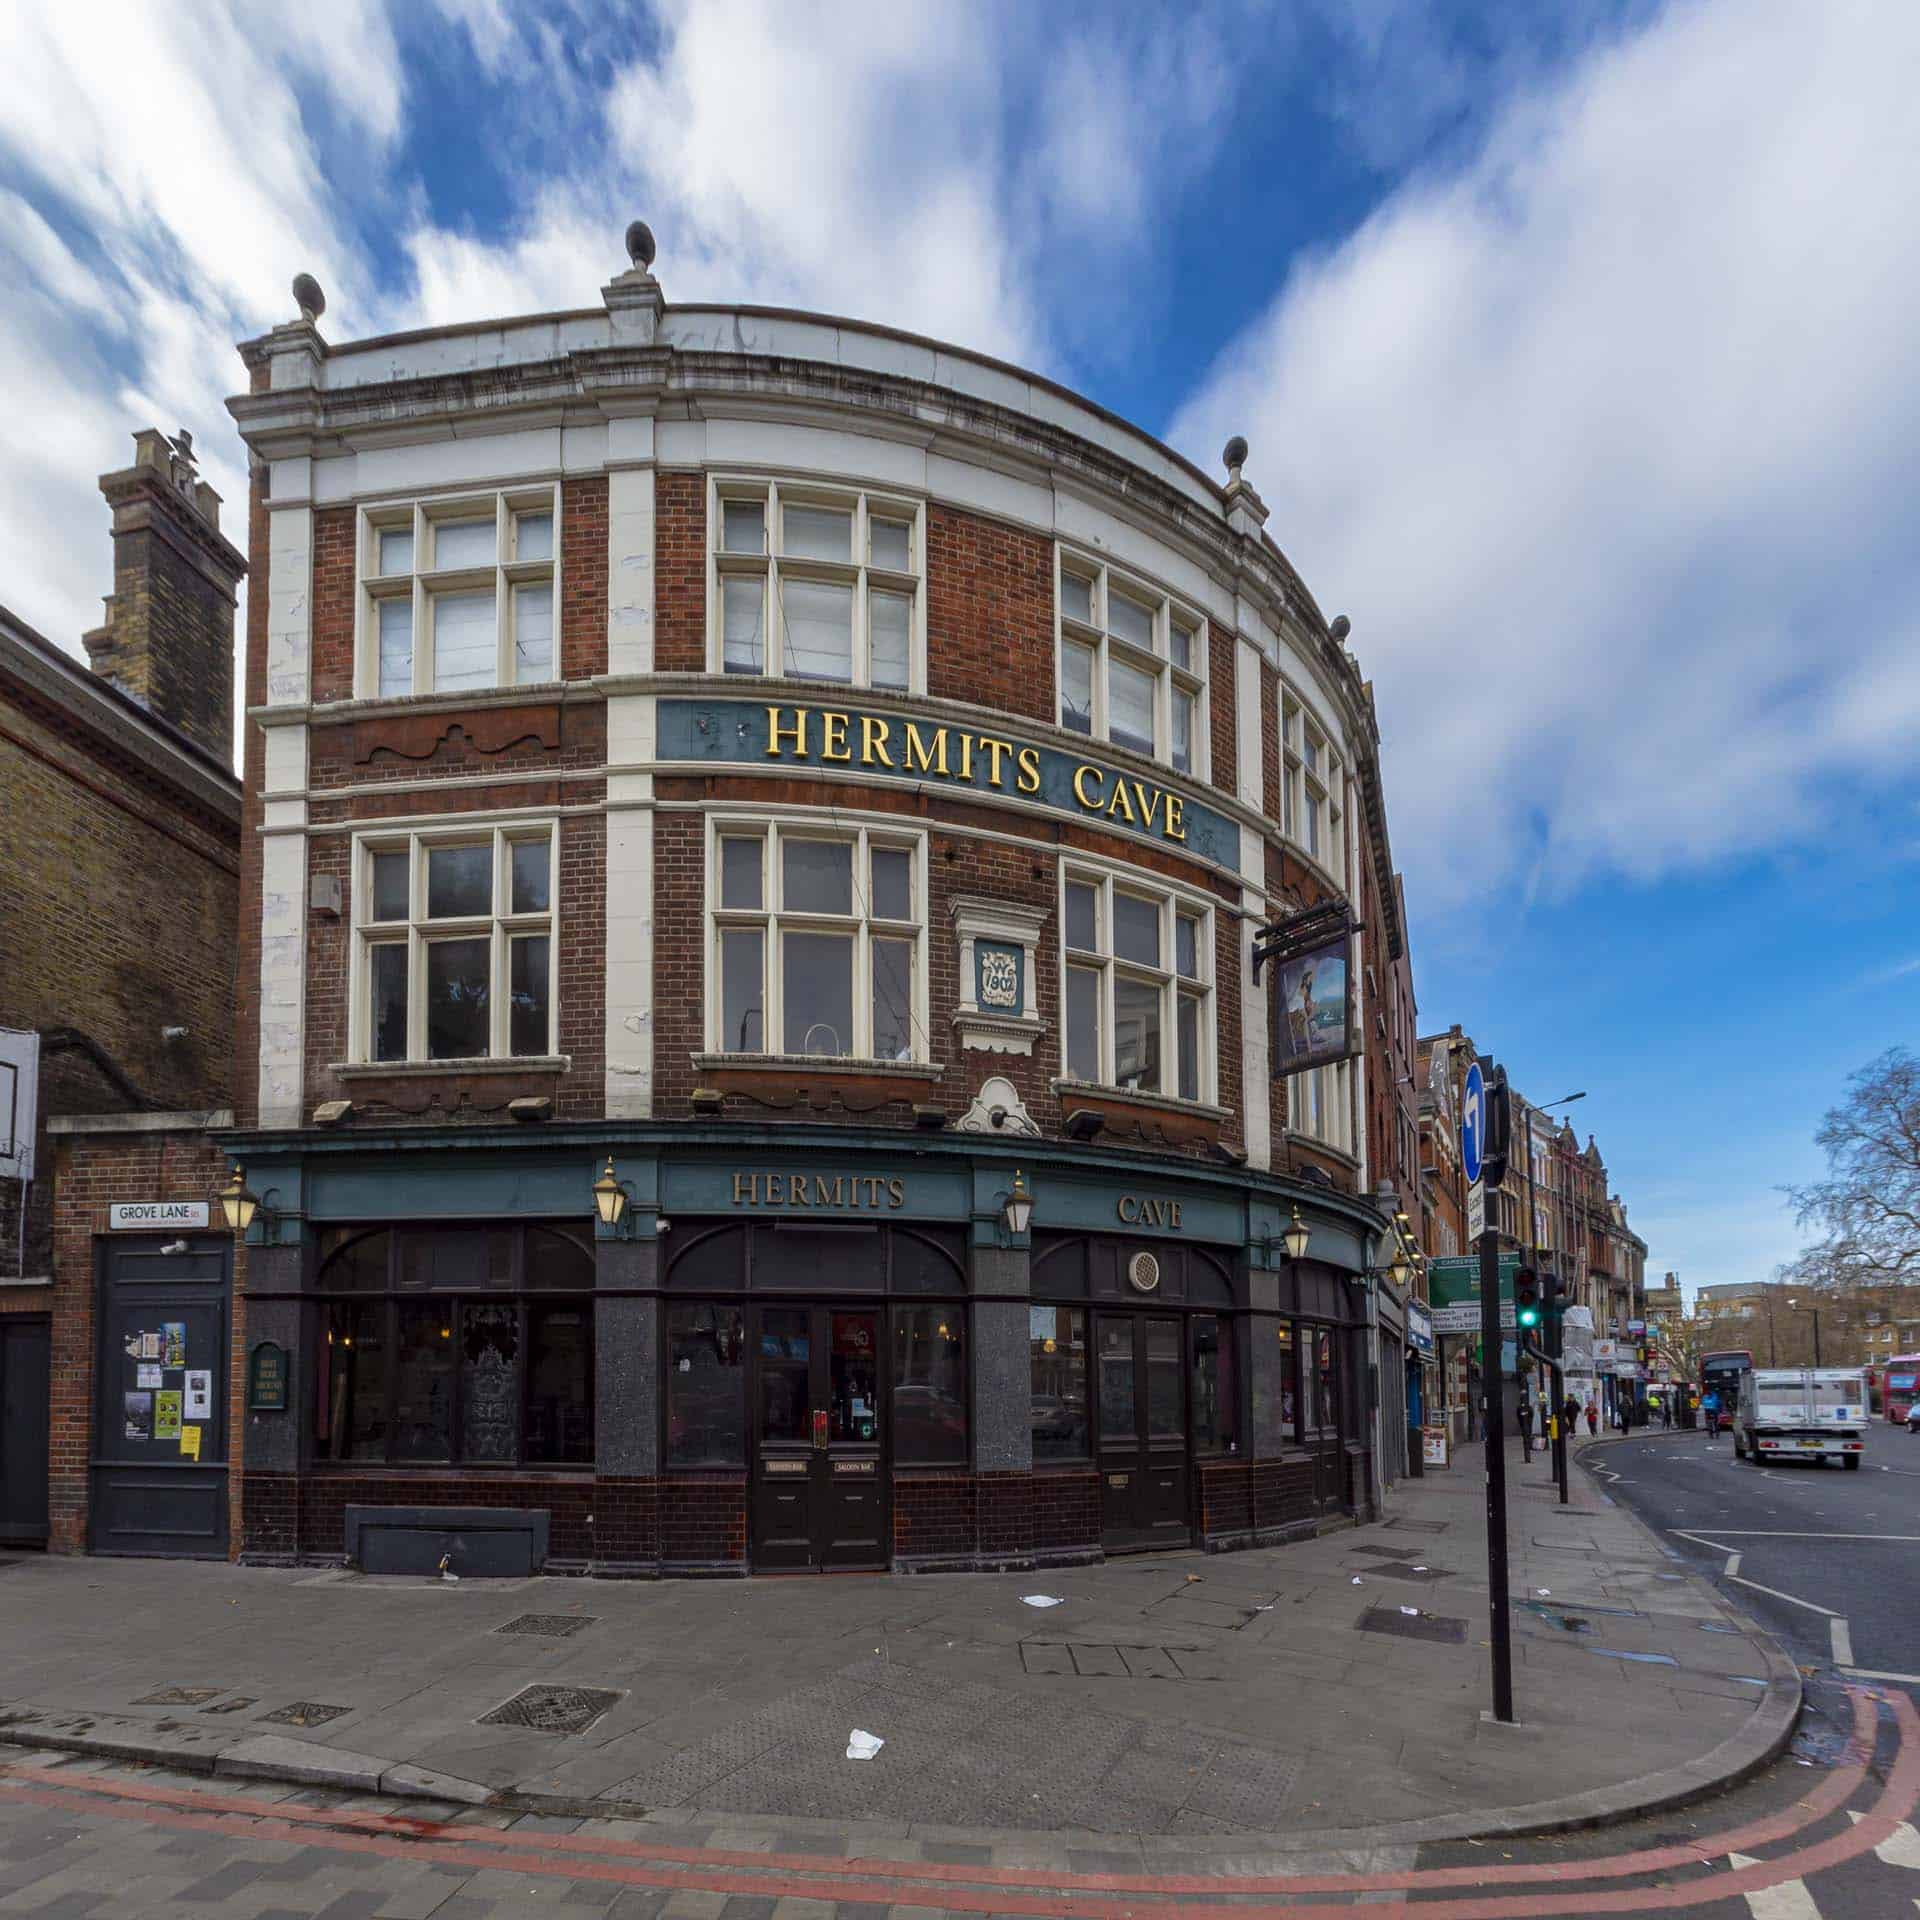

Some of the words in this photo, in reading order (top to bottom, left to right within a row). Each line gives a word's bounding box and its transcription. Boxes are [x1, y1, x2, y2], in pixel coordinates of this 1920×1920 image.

[765, 707, 1041, 794] HERMITS
[1073, 765, 1187, 841] CAVE
[986, 974, 1014, 992] 1902
[732, 1173, 905, 1209] HERMITS
[119, 1206, 157, 1219] GROVE
[160, 1205, 189, 1218] LANE
[1117, 1195, 1185, 1229] CAVE
[837, 1463, 860, 1471] SALOON
